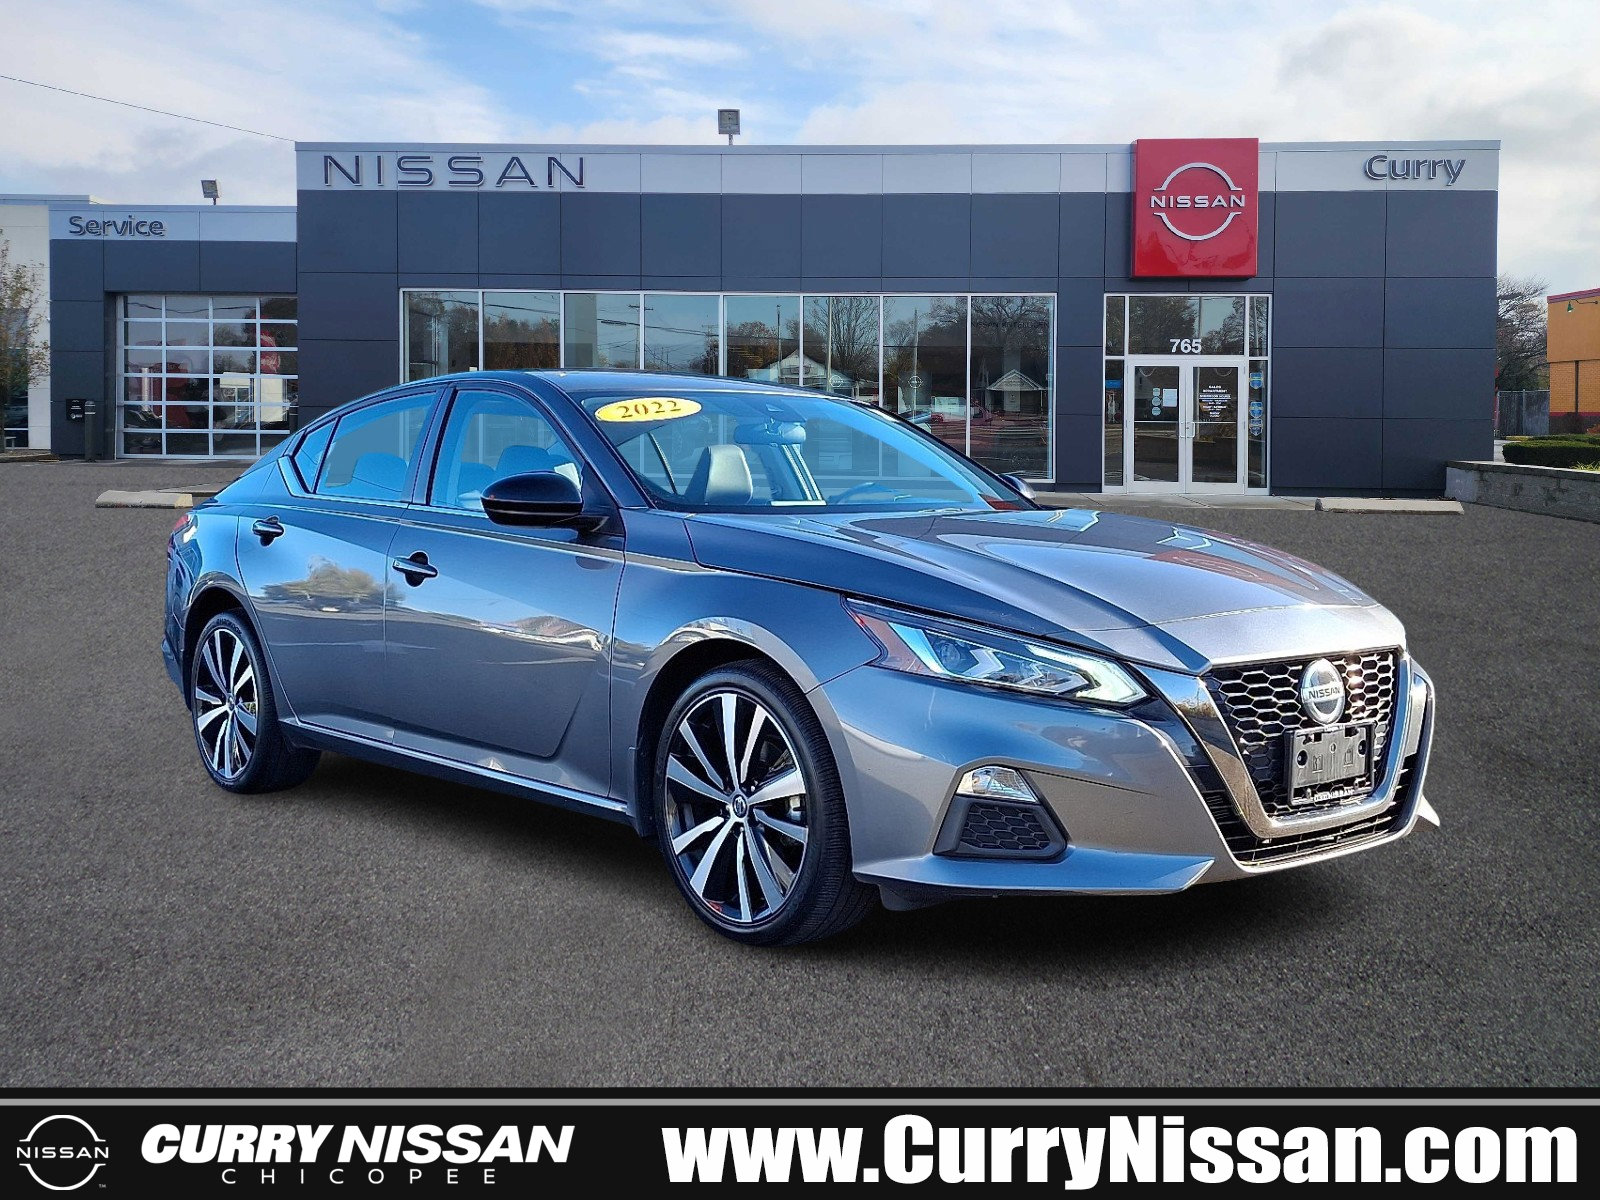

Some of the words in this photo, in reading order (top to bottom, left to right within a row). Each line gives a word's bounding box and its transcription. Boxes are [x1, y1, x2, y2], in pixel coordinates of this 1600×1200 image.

[323, 155, 586, 188] NISSAN
[1364, 154, 1467, 186] Curry
[1150, 194, 1246, 208] NISSAN
[69, 214, 166, 237] Service
[1169, 338, 1203, 354] 765
[616, 400, 681, 418] 2022
[1308, 687, 1340, 699] NISSAN
